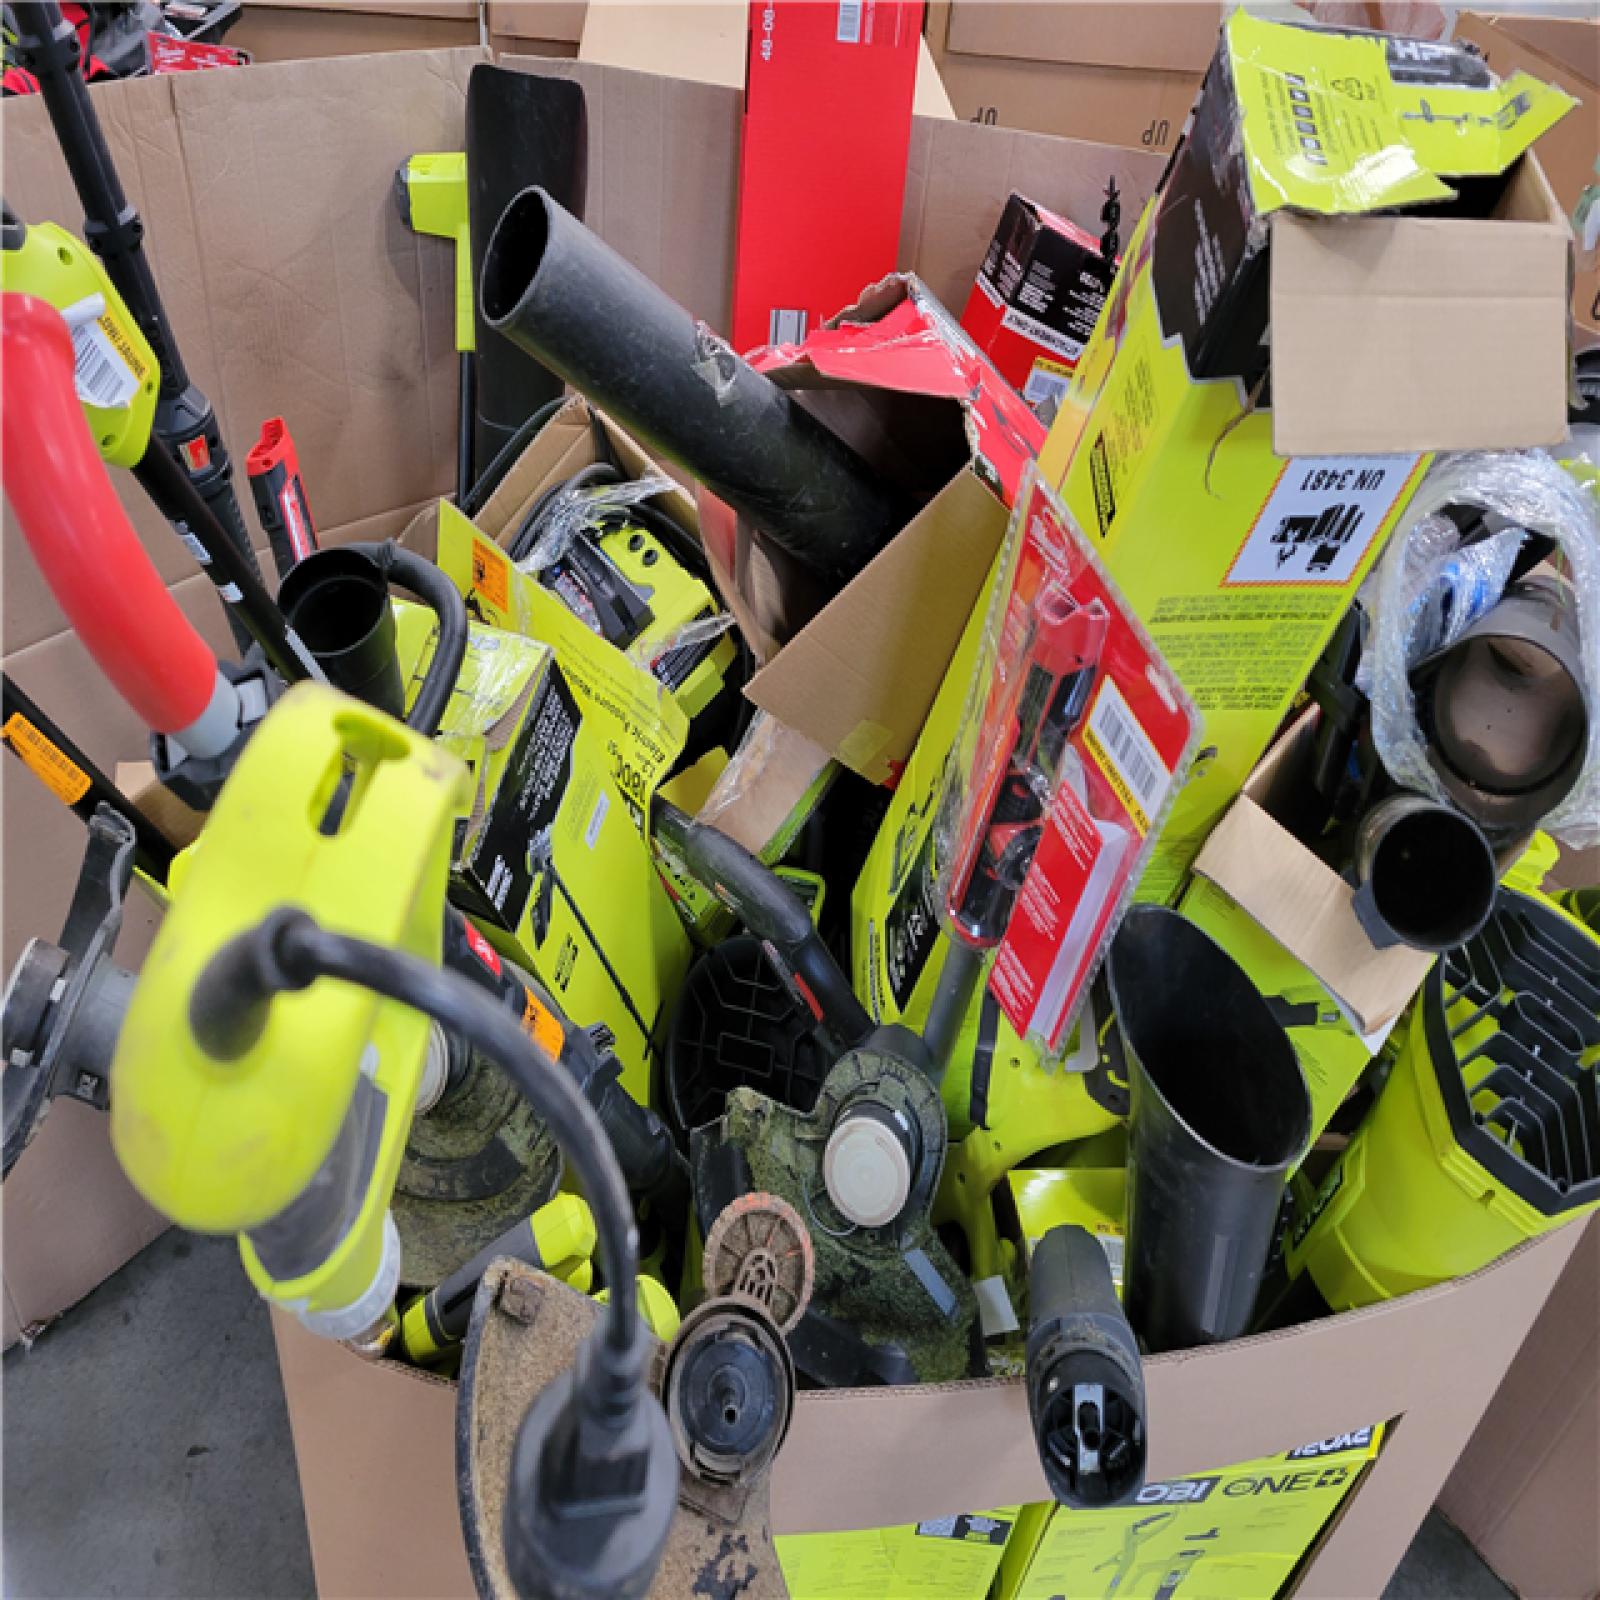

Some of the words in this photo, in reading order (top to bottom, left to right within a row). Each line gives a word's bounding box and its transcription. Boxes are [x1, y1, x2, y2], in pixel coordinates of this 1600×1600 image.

[1141, 119, 1170, 146] UP
[1300, 469, 1354, 491] 3481
[1352, 469, 1386, 491] UN
[1136, 1480, 1211, 1503] OBI
